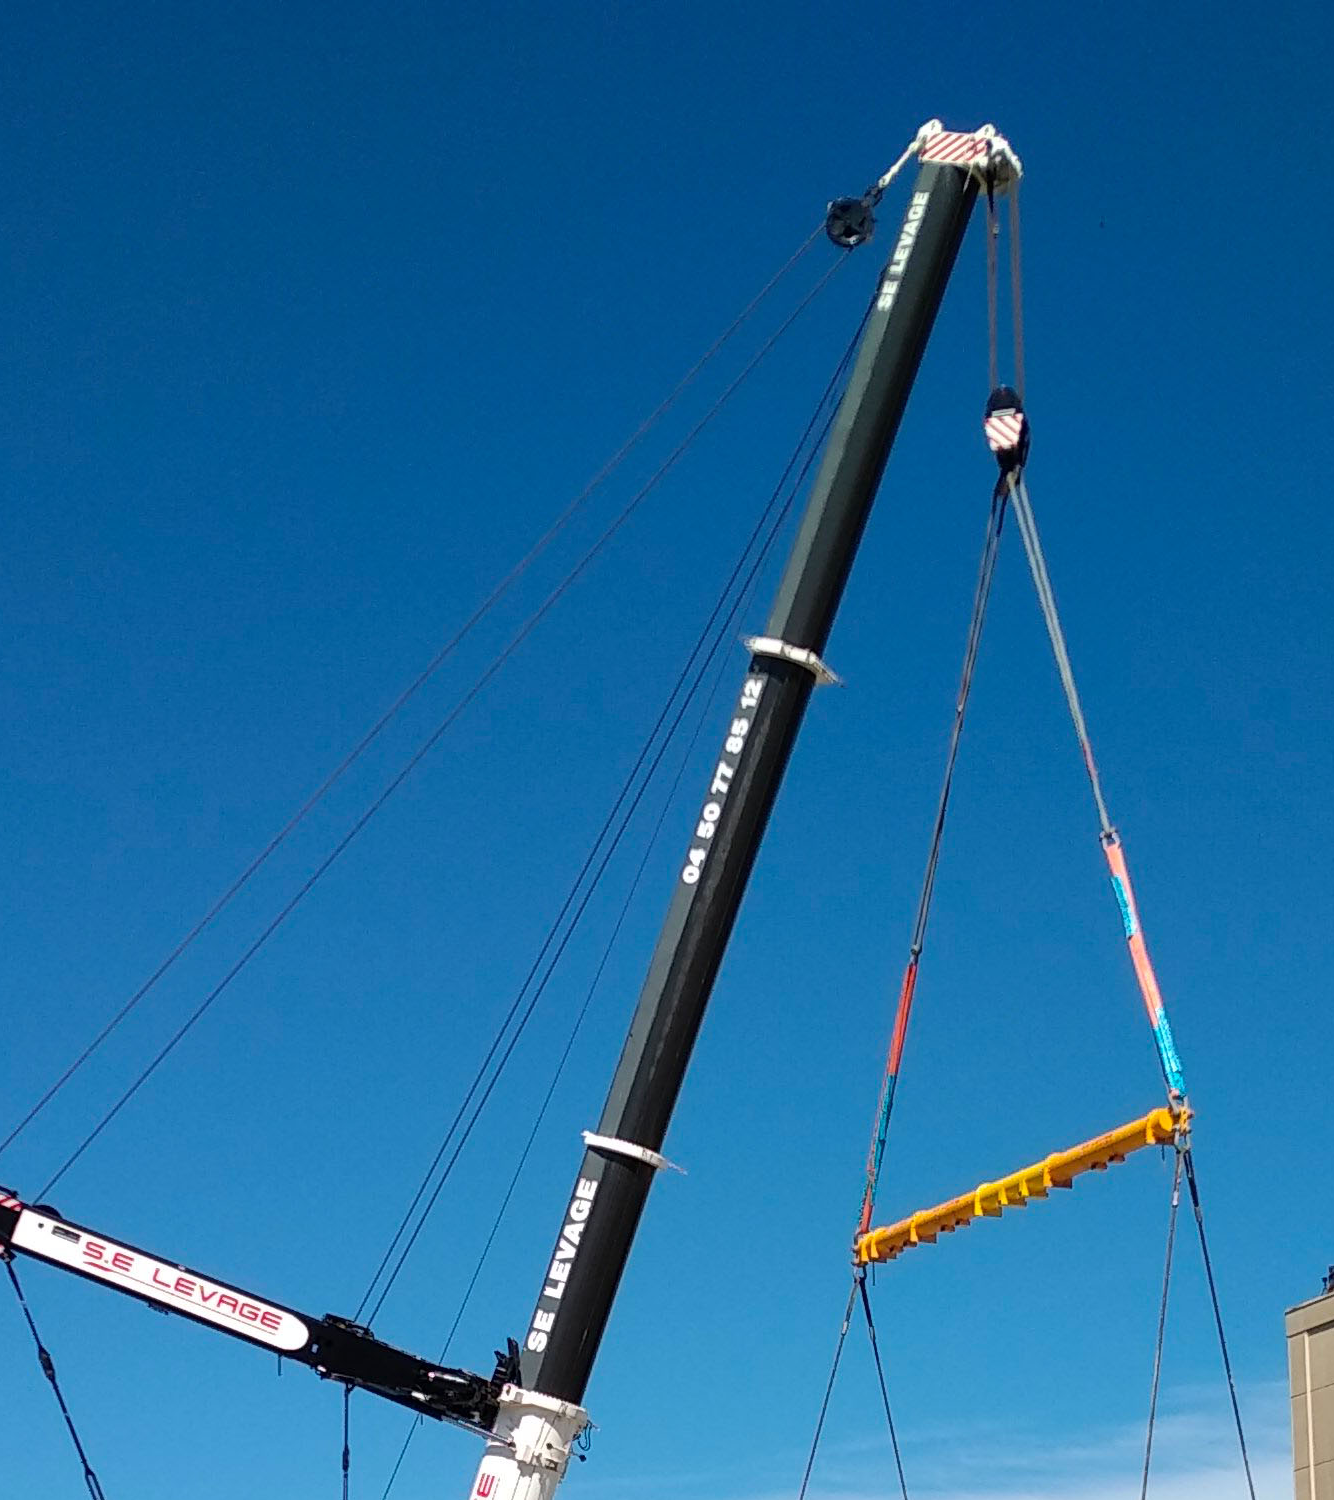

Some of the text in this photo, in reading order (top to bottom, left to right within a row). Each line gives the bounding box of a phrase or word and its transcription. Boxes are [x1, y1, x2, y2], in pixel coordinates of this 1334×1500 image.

[877, 191, 930, 312] SE LEVAGE
[682, 679, 764, 884] 04 50 77 85 12
[152, 1268, 283, 1332] LEVAGE
[527, 1178, 598, 1353] SE LEVAGE
